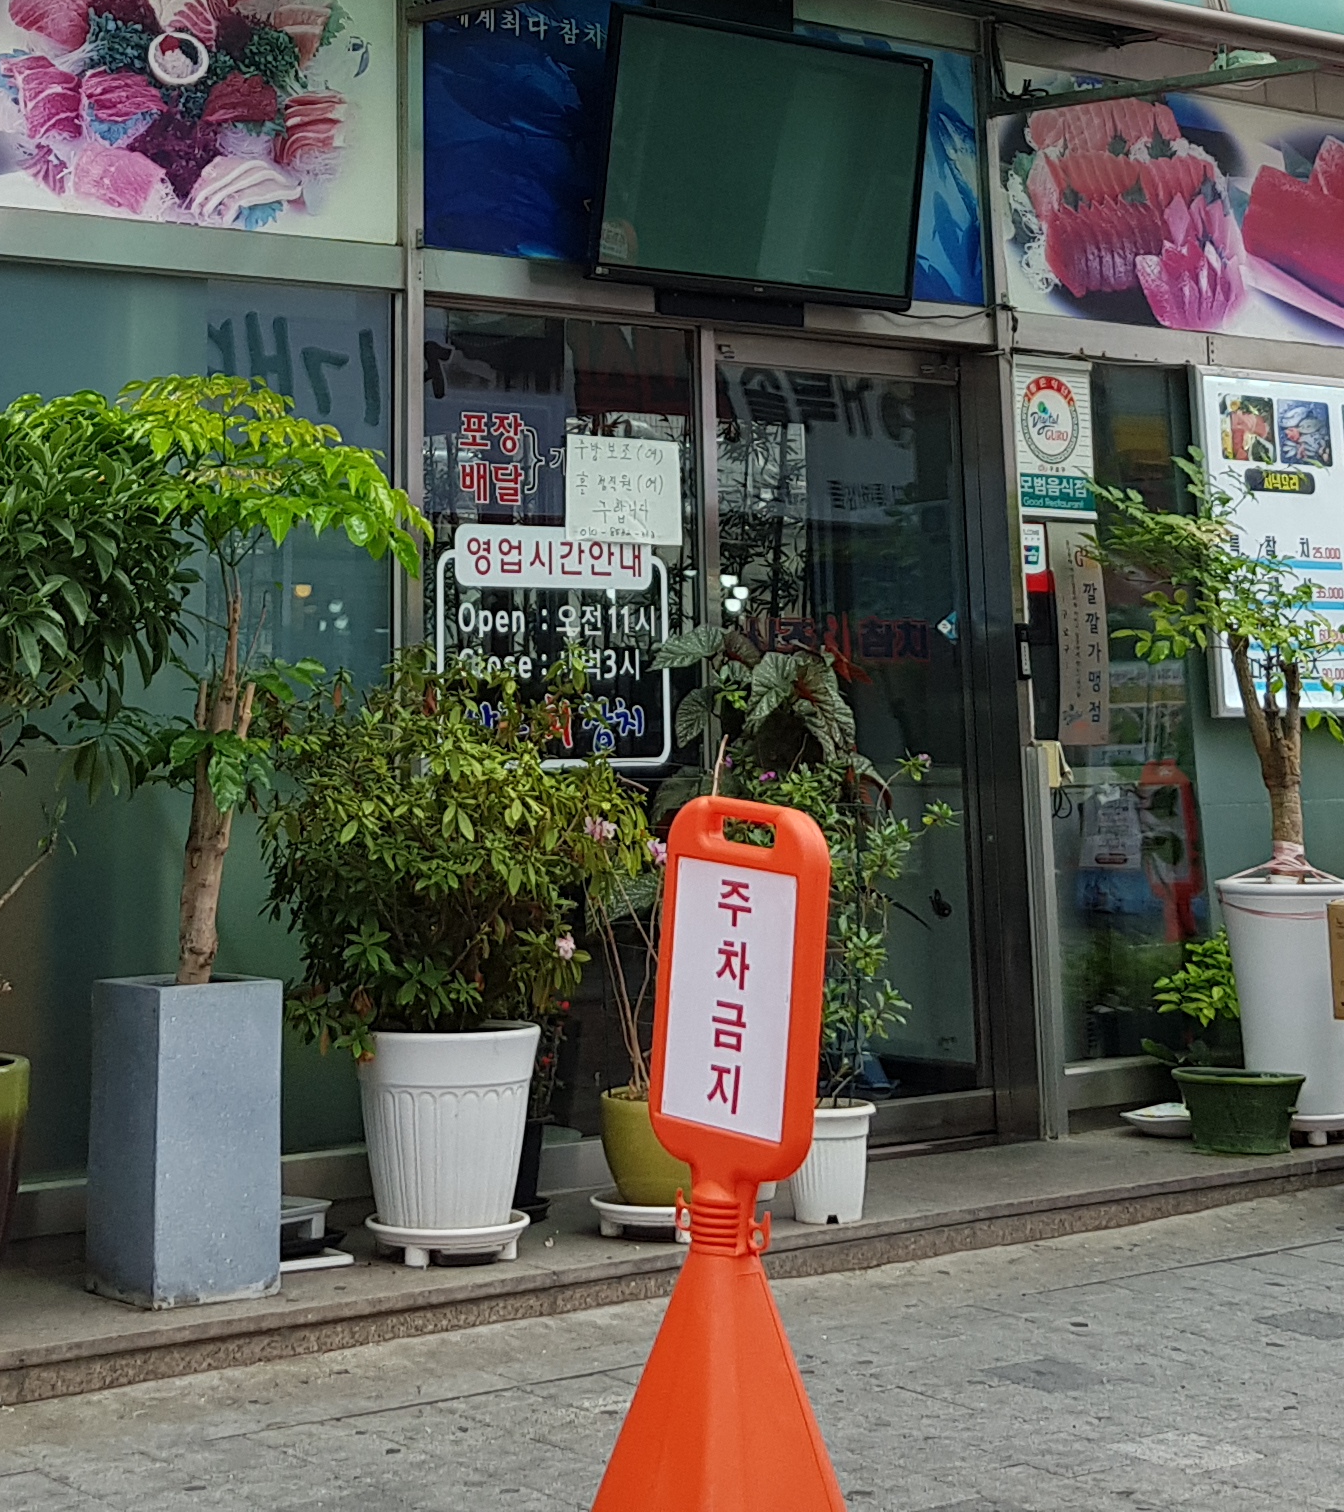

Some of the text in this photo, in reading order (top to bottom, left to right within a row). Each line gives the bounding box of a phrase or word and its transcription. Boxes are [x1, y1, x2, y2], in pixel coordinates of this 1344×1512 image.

[559, 18, 603, 50] 참치
[458, 410, 524, 456] 포장
[1045, 430, 1068, 442] GURO
[459, 460, 524, 506] 배달
[1020, 475, 1088, 498] 모범음식점
[1023, 496, 1085, 509] Good Restaurant
[467, 537, 642, 578] 영업시간안내
[458, 602, 526, 638] Open
[707, 878, 753, 1115] 주차금지
